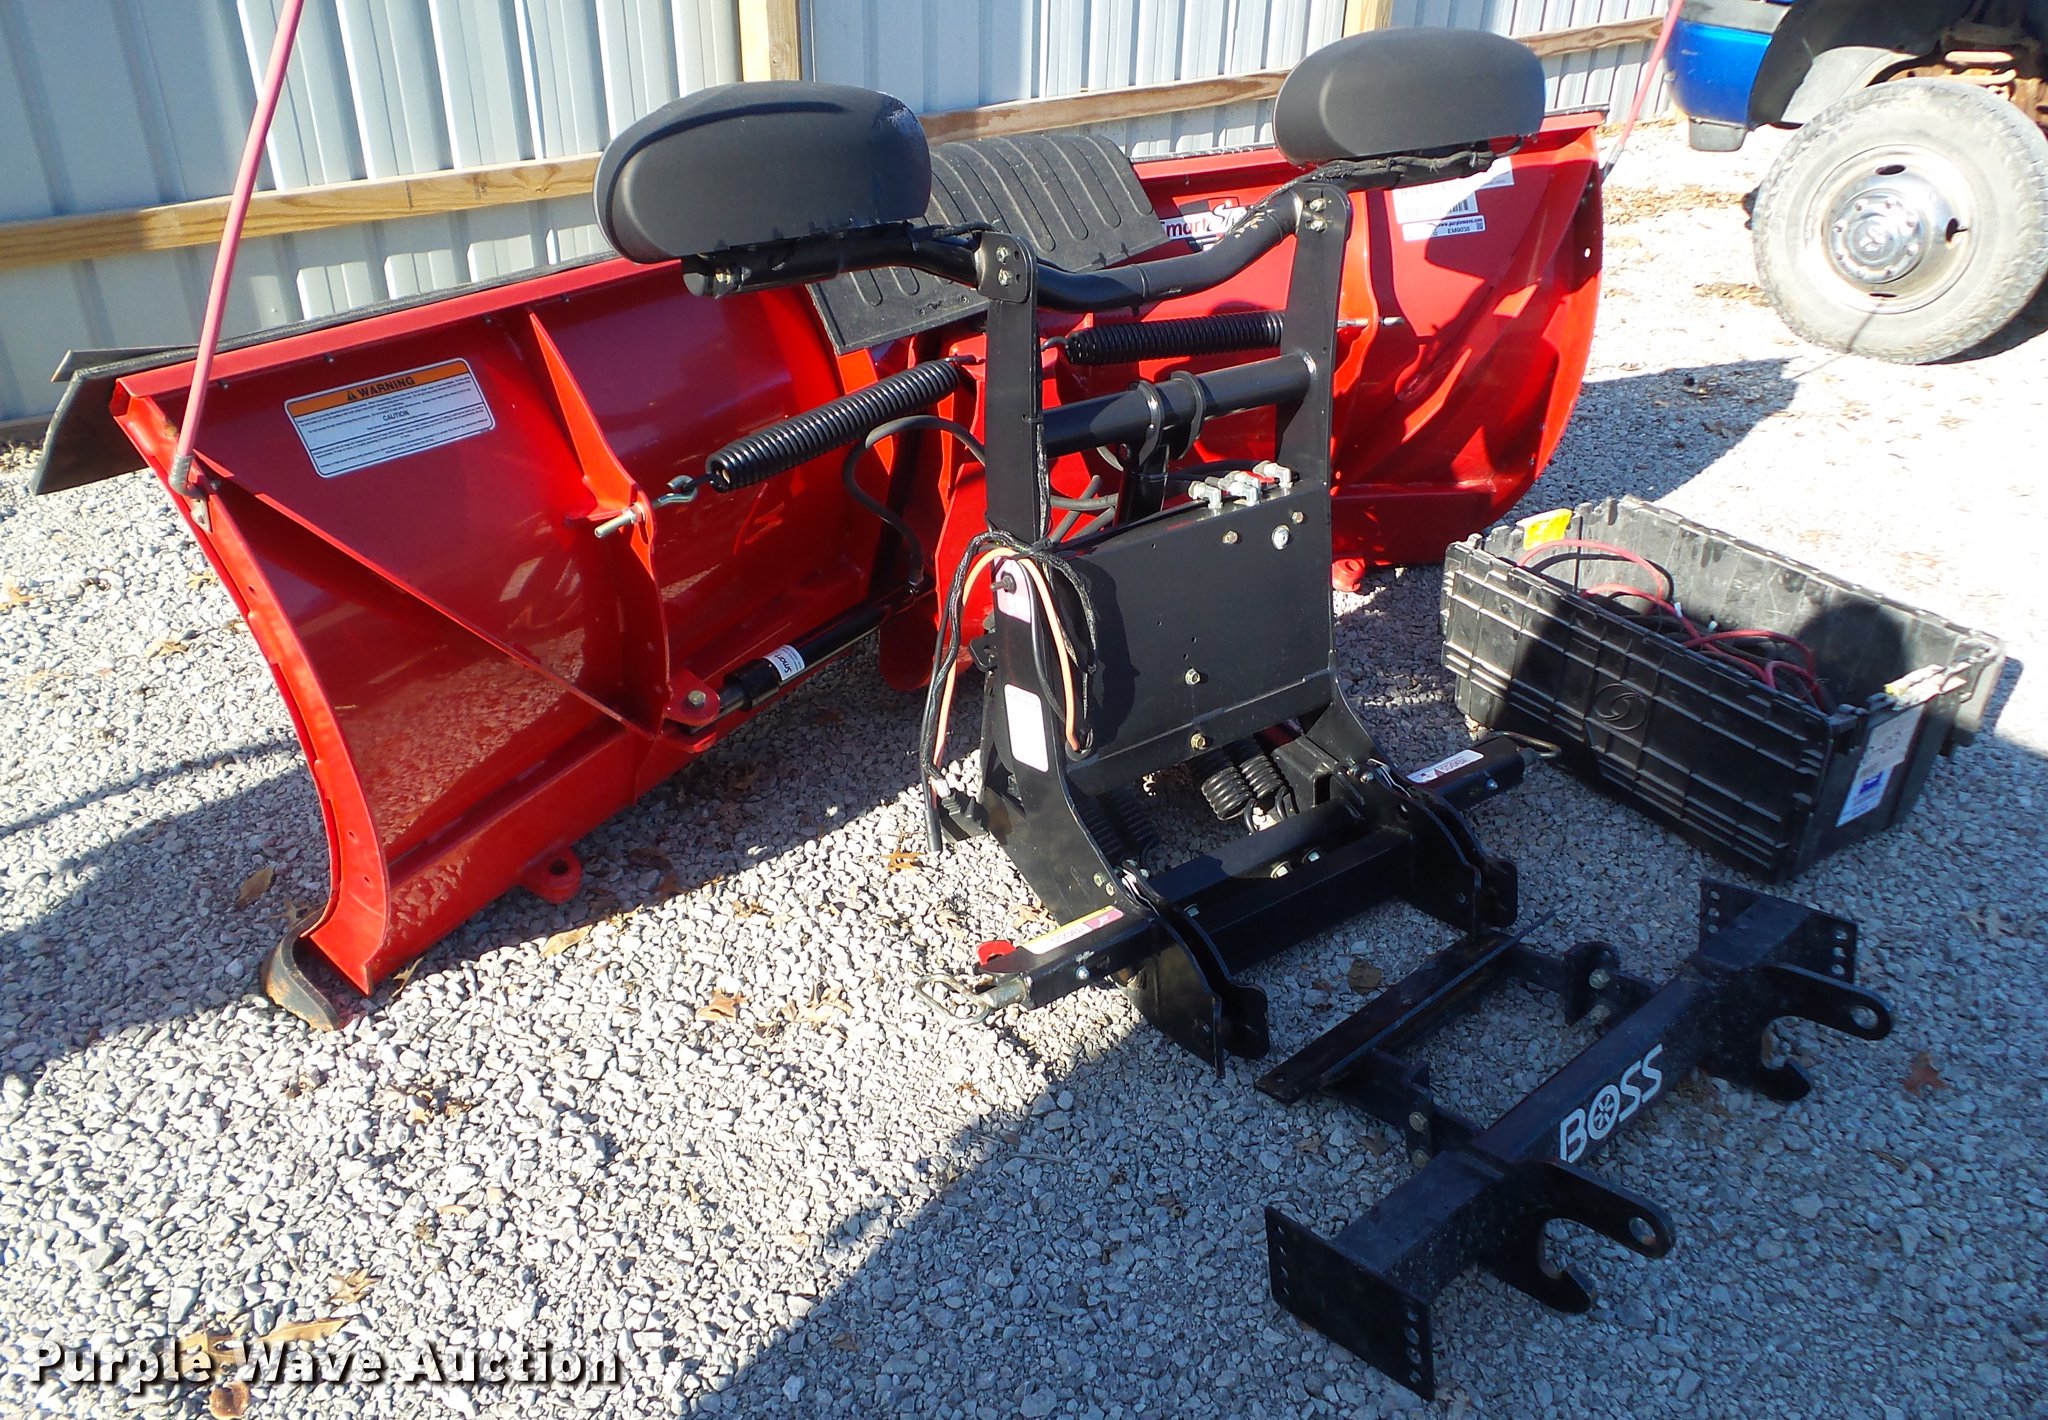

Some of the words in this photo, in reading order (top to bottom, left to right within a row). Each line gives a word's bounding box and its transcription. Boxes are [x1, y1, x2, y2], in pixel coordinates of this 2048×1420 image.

[356, 375, 417, 399] WARNING
[382, 408, 410, 422] CAUTION
[1560, 1043, 1663, 1164] BOSS
